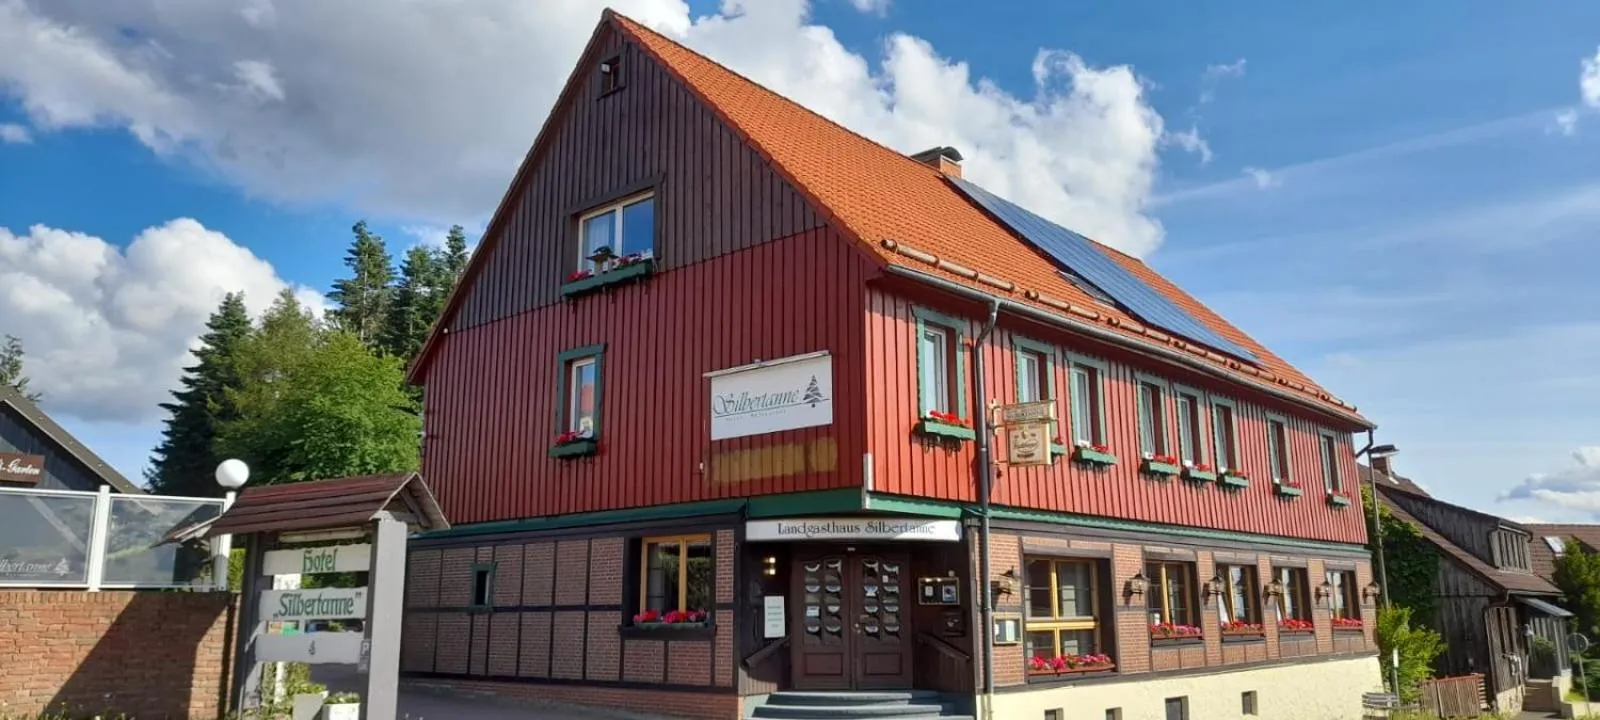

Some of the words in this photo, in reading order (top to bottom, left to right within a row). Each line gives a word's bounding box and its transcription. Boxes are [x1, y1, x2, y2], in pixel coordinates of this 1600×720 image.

[713, 389, 799, 415] Silbertanne
[778, 522, 860, 537] Landgasthaus
[865, 522, 936, 535] Silbertanne
[303, 548, 338, 572] Hotel
